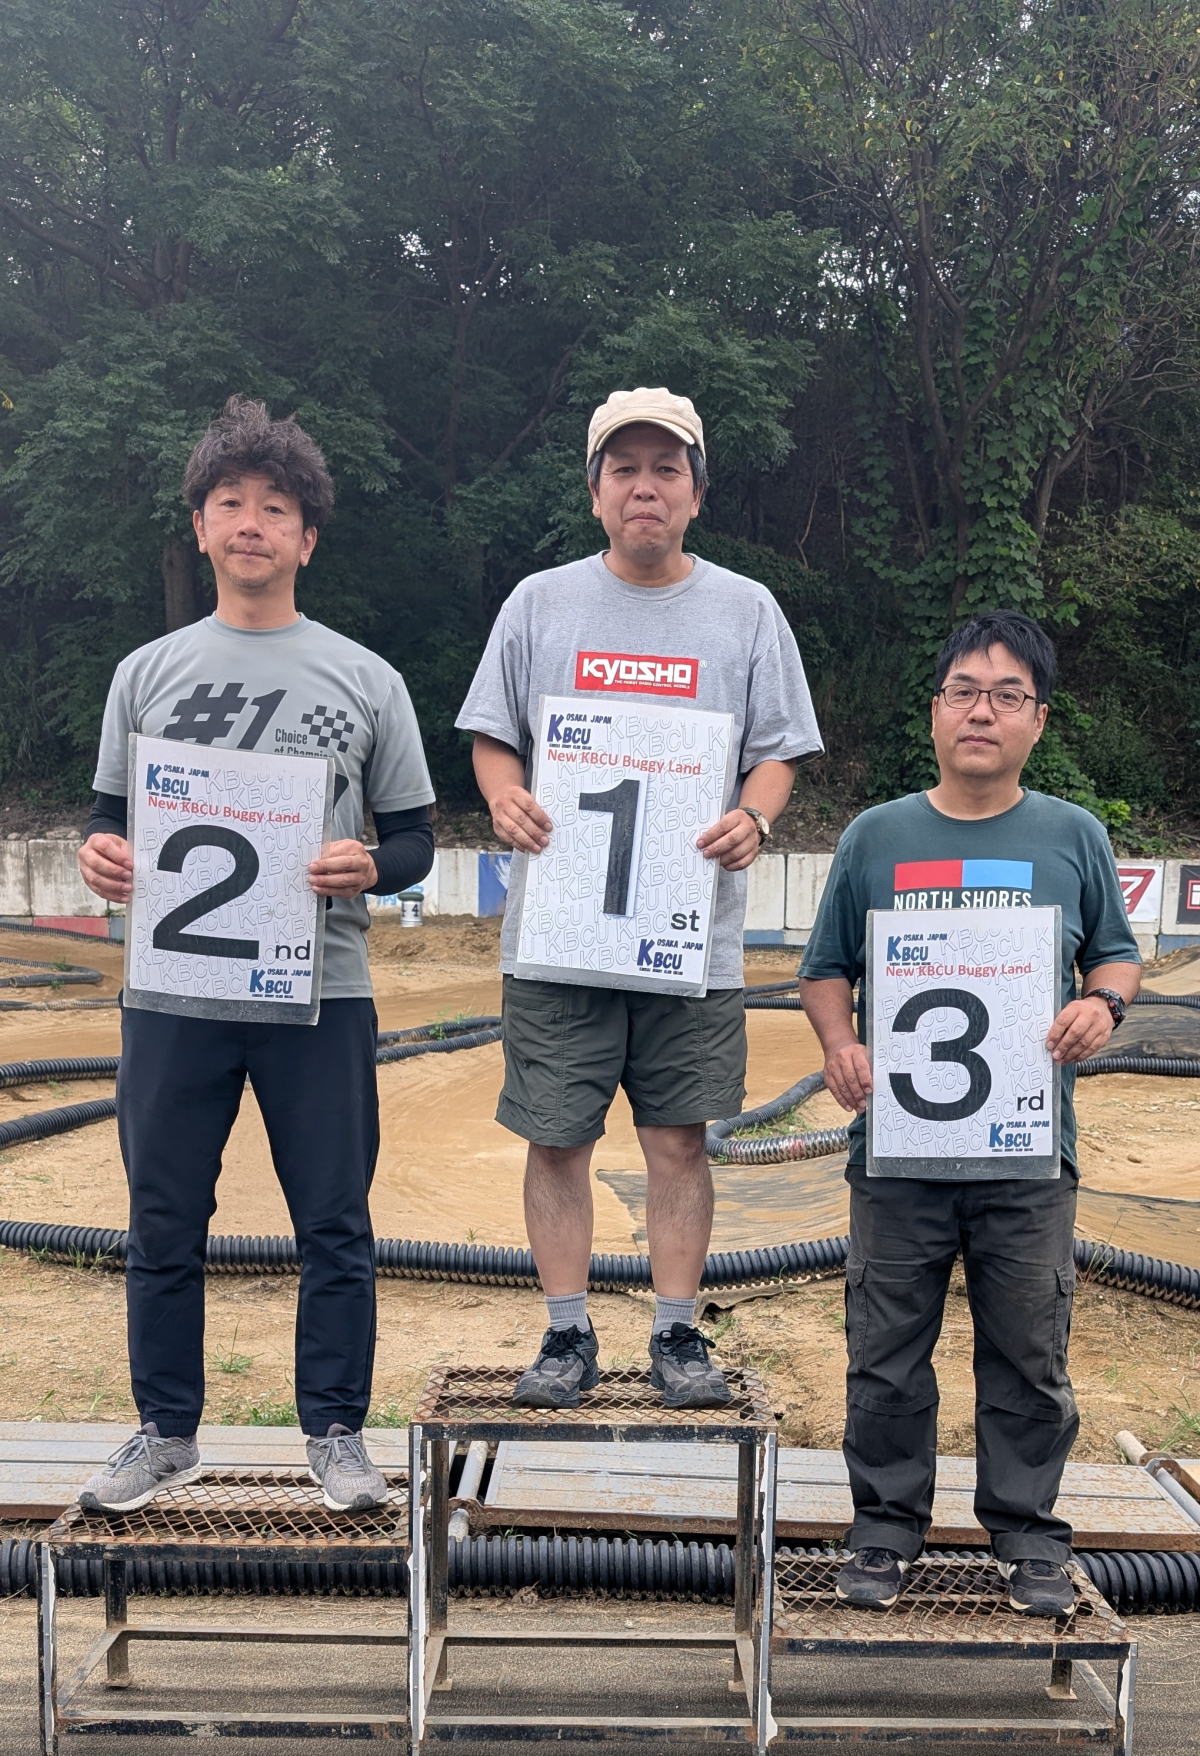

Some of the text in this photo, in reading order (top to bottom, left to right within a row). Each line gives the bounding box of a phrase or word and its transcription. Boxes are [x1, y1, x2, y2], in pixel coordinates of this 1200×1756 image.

[582, 657, 692, 685] KYOSHO
[163, 682, 288, 750] #1
[566, 713, 612, 724] OSAKA JAPAN
[275, 728, 308, 745] Choice
[547, 714, 591, 745] KBCU
[163, 764, 210, 778] OSAKA JAPAN
[547, 749, 701, 775] New KBCU Buggy Land
[146, 763, 190, 795] KBCU
[148, 796, 177, 810] New
[182, 801, 219, 816] KBCU
[223, 807, 265, 823] Buggy
[269, 811, 301, 824] Land
[153, 824, 260, 960] 2
[894, 890, 1032, 911] NORTH SHORES
[671, 909, 700, 932] st
[657, 939, 703, 950] OSAKA JAPAN
[886, 935, 929, 961] KBCU
[903, 933, 948, 942] OSAKA JAPAN
[275, 940, 311, 960] nd
[637, 938, 682, 970] KBCU
[249, 969, 293, 994] KBCU
[267, 968, 288, 976] OSAKA
[886, 963, 1032, 977] New KBCU Buggy Land
[888, 987, 992, 1121] 3
[1017, 1089, 1044, 1111] rd
[989, 1123, 1031, 1147] KBCU
[1030, 1120, 1050, 1128] JAPAN
